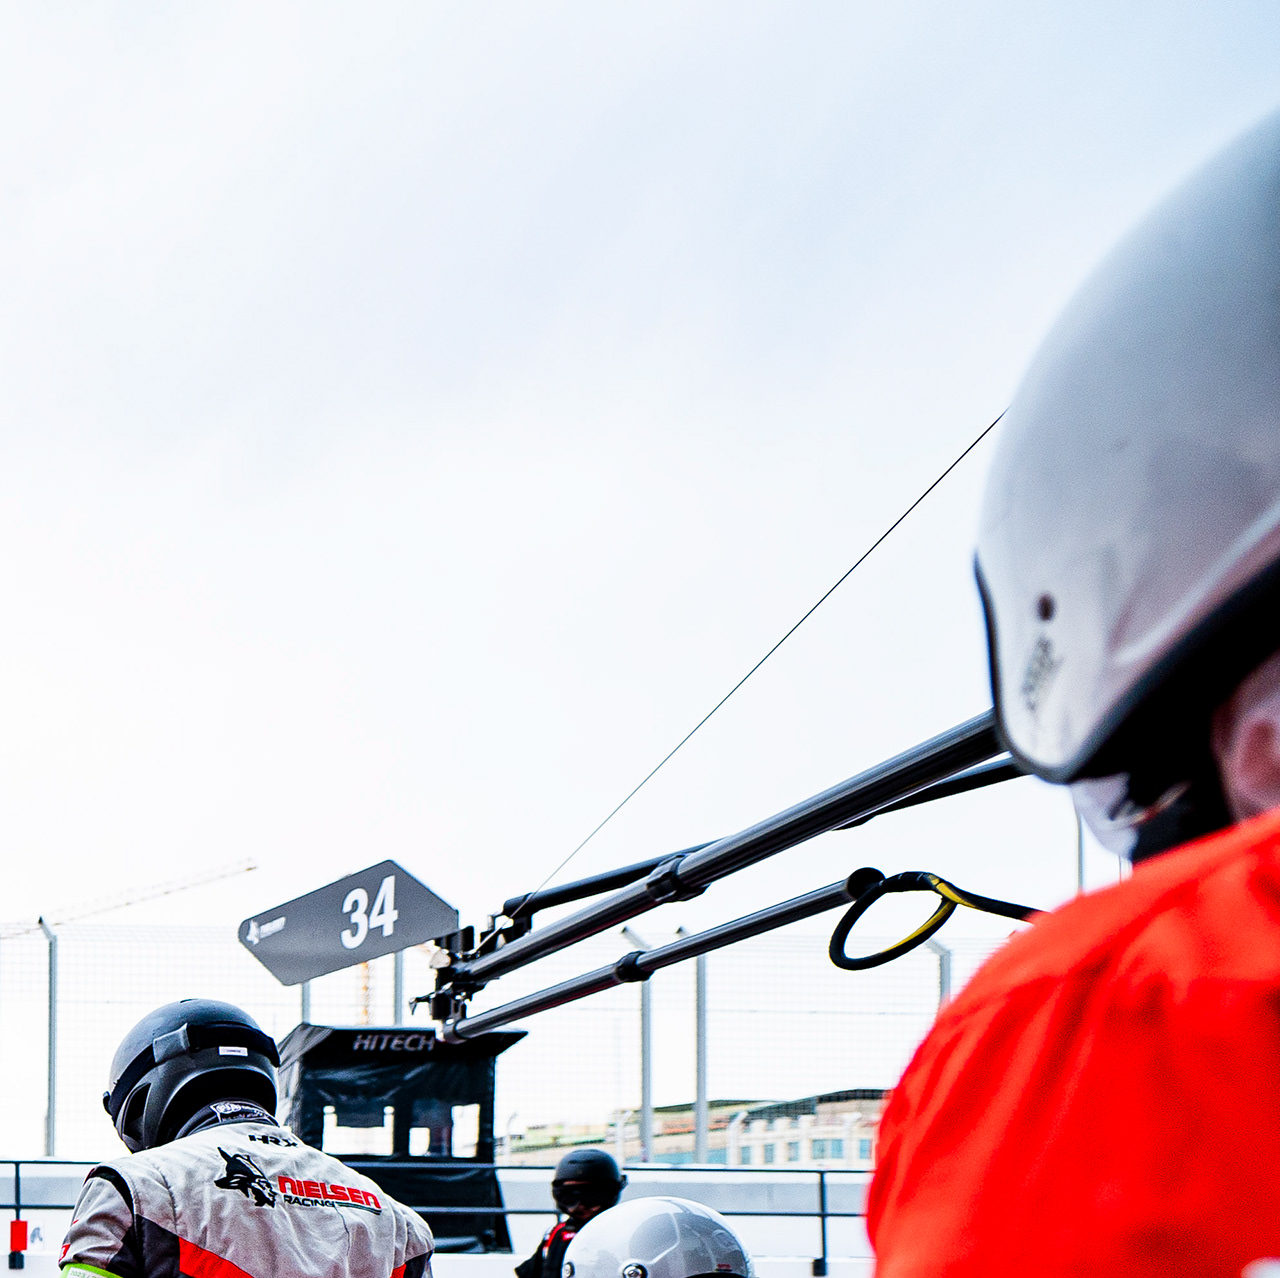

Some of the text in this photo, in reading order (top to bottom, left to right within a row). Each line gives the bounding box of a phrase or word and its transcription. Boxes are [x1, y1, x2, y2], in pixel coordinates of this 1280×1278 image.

[341, 874, 399, 949] 34
[353, 1033, 436, 1051] HITECH
[248, 1134, 299, 1148] HRX
[277, 1175, 382, 1209] NIELSEN
[283, 1194, 335, 1207] RACING
